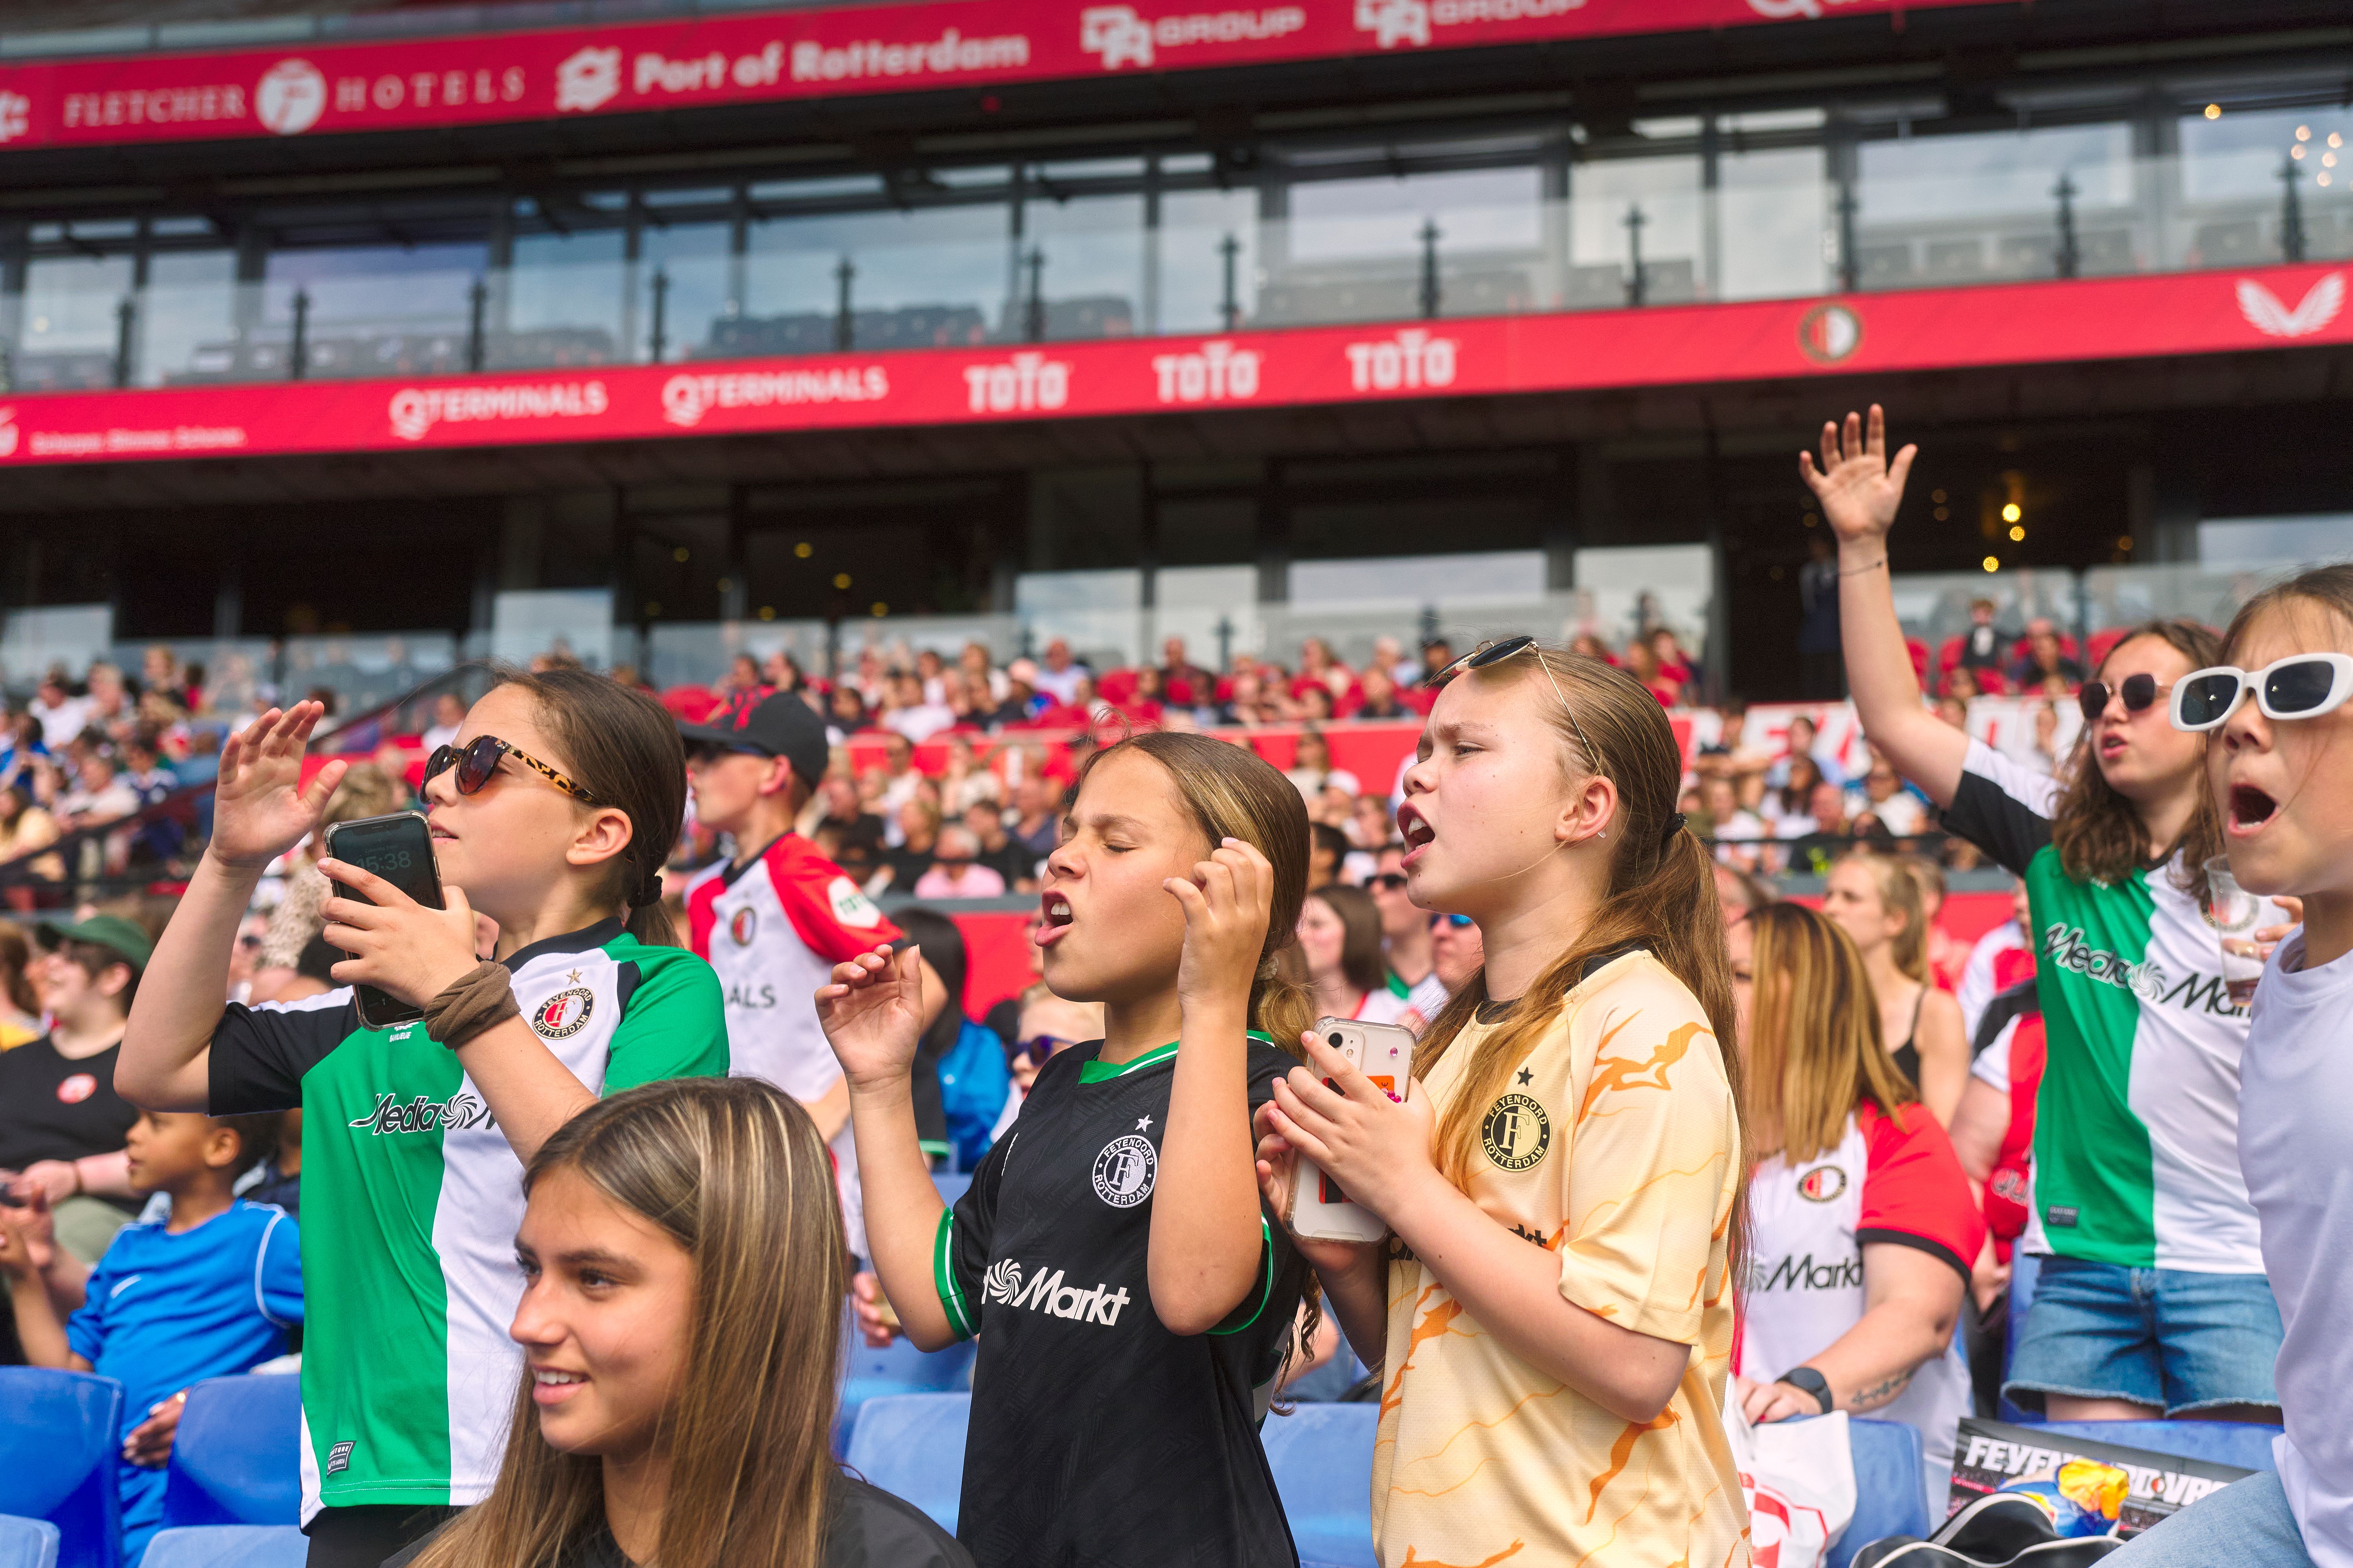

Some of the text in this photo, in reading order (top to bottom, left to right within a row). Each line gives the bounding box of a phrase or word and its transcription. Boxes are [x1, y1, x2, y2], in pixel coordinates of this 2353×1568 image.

[1156, 6, 1306, 47] GROUP
[634, 28, 1030, 94] Port of Rotterdam
[63, 84, 247, 129] FLETCHER
[335, 66, 525, 112] HOTELS
[1151, 341, 1265, 403] TOTO
[1345, 328, 1461, 391] TOTO
[963, 351, 1073, 413] TOTO
[356, 851, 411, 873] 15:38
[542, 989, 592, 1009] FEYENOORD
[723, 983, 777, 1008] ALS
[534, 1014, 589, 1037] ROTTERDAM
[348, 1093, 443, 1135] Media
[1488, 1095, 1547, 1125] FEYENOORD
[1104, 1138, 1154, 1165] FEYENOORD
[1484, 1137, 1545, 1169] ROTTERDAM
[1095, 1174, 1150, 1205] ROTTERDAM
[1011, 1267, 1130, 1326] Markt
